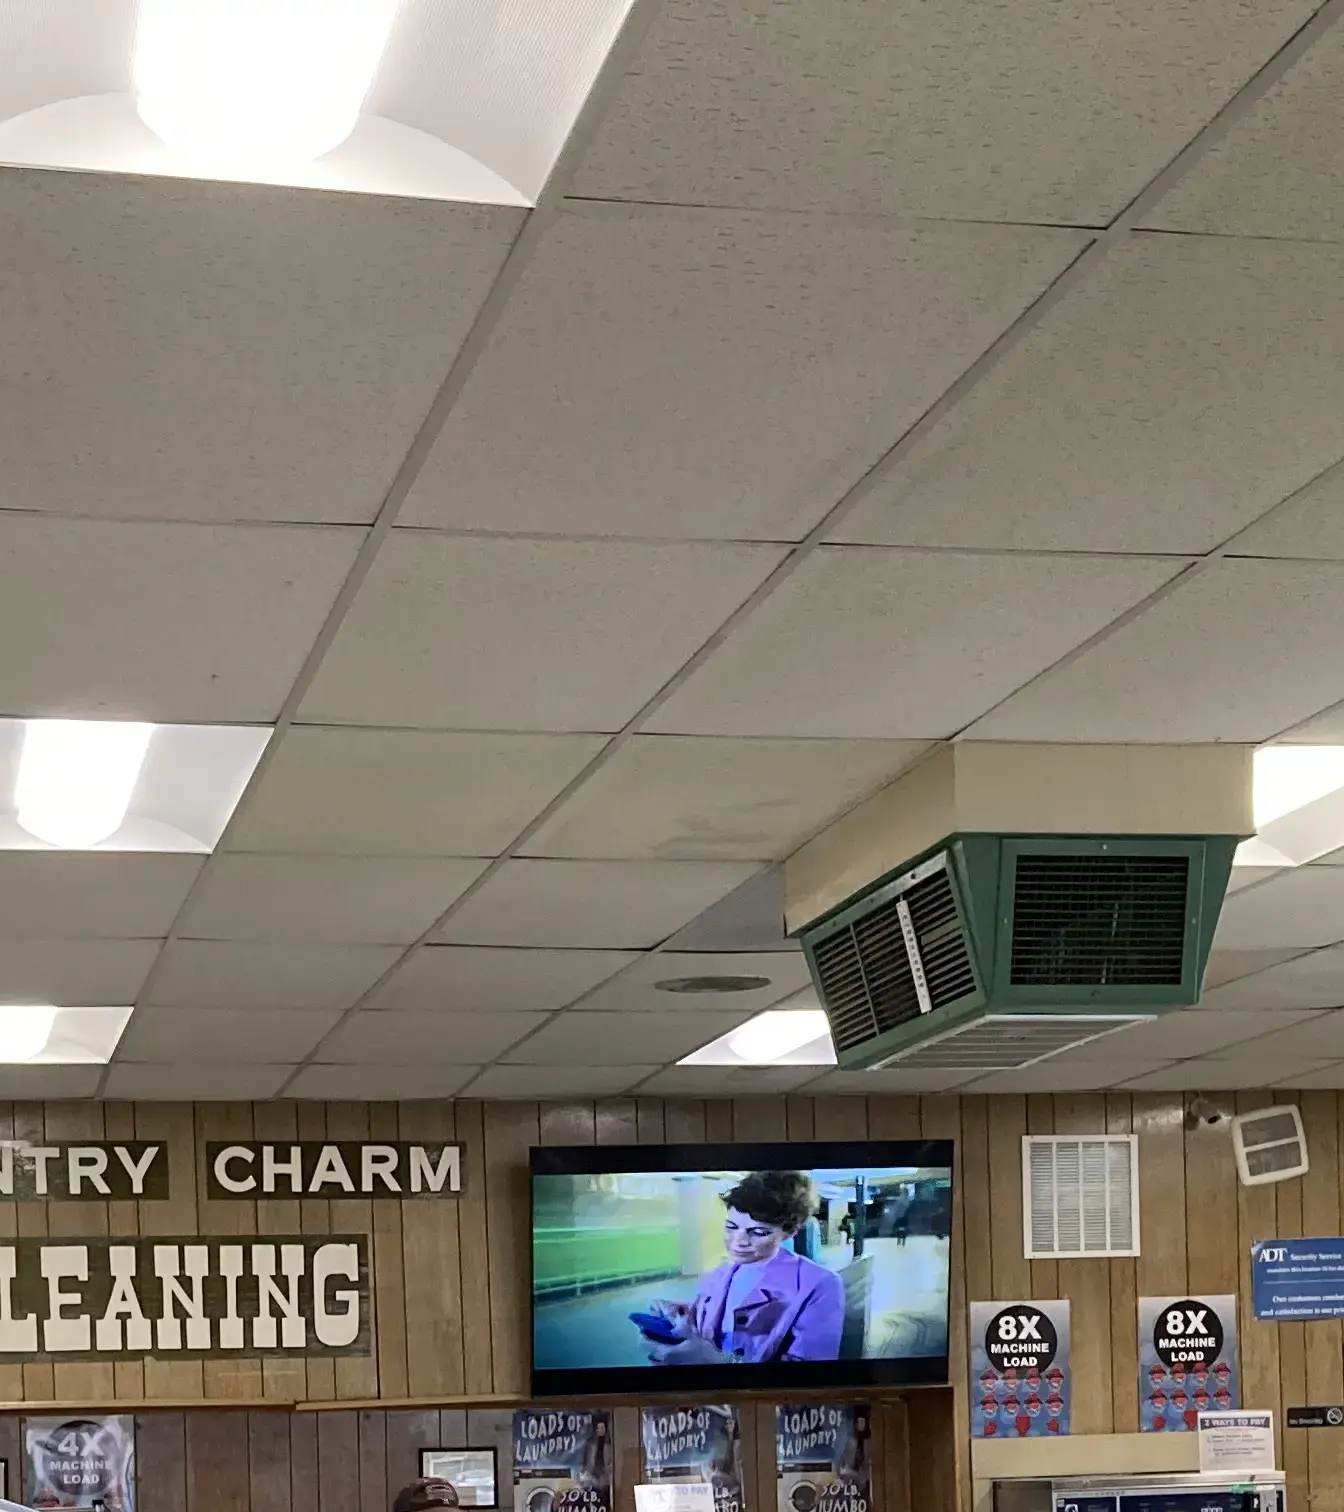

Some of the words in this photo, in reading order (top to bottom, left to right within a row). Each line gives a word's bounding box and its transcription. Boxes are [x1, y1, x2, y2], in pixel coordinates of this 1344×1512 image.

[213, 1145, 461, 1194] CHARM
[1258, 1247, 1288, 1263] ADT
[1290, 1253, 1317, 1262] Security
[1319, 1252, 1342, 1260] Service
[998, 1315, 1042, 1341] 8X
[1165, 1310, 1208, 1335] 8X
[990, 1342, 1050, 1354] MACHINE
[1158, 1337, 1216, 1349] MACHINE
[1003, 1356, 1038, 1368] LOAD
[1170, 1351, 1205, 1363] LOAD
[521, 1411, 564, 1440] LOADS
[567, 1414, 582, 1433] OF
[652, 1408, 693, 1438] LOADS
[697, 1411, 710, 1430] OF
[784, 1405, 825, 1434] LOADS
[829, 1410, 842, 1428] OF
[58, 1432, 104, 1456] 4X
[50, 1460, 111, 1471] MACHINE
[63, 1475, 100, 1485] LOAD
[582, 1489, 601, 1503] LB.
[844, 1483, 861, 1497] LB.
